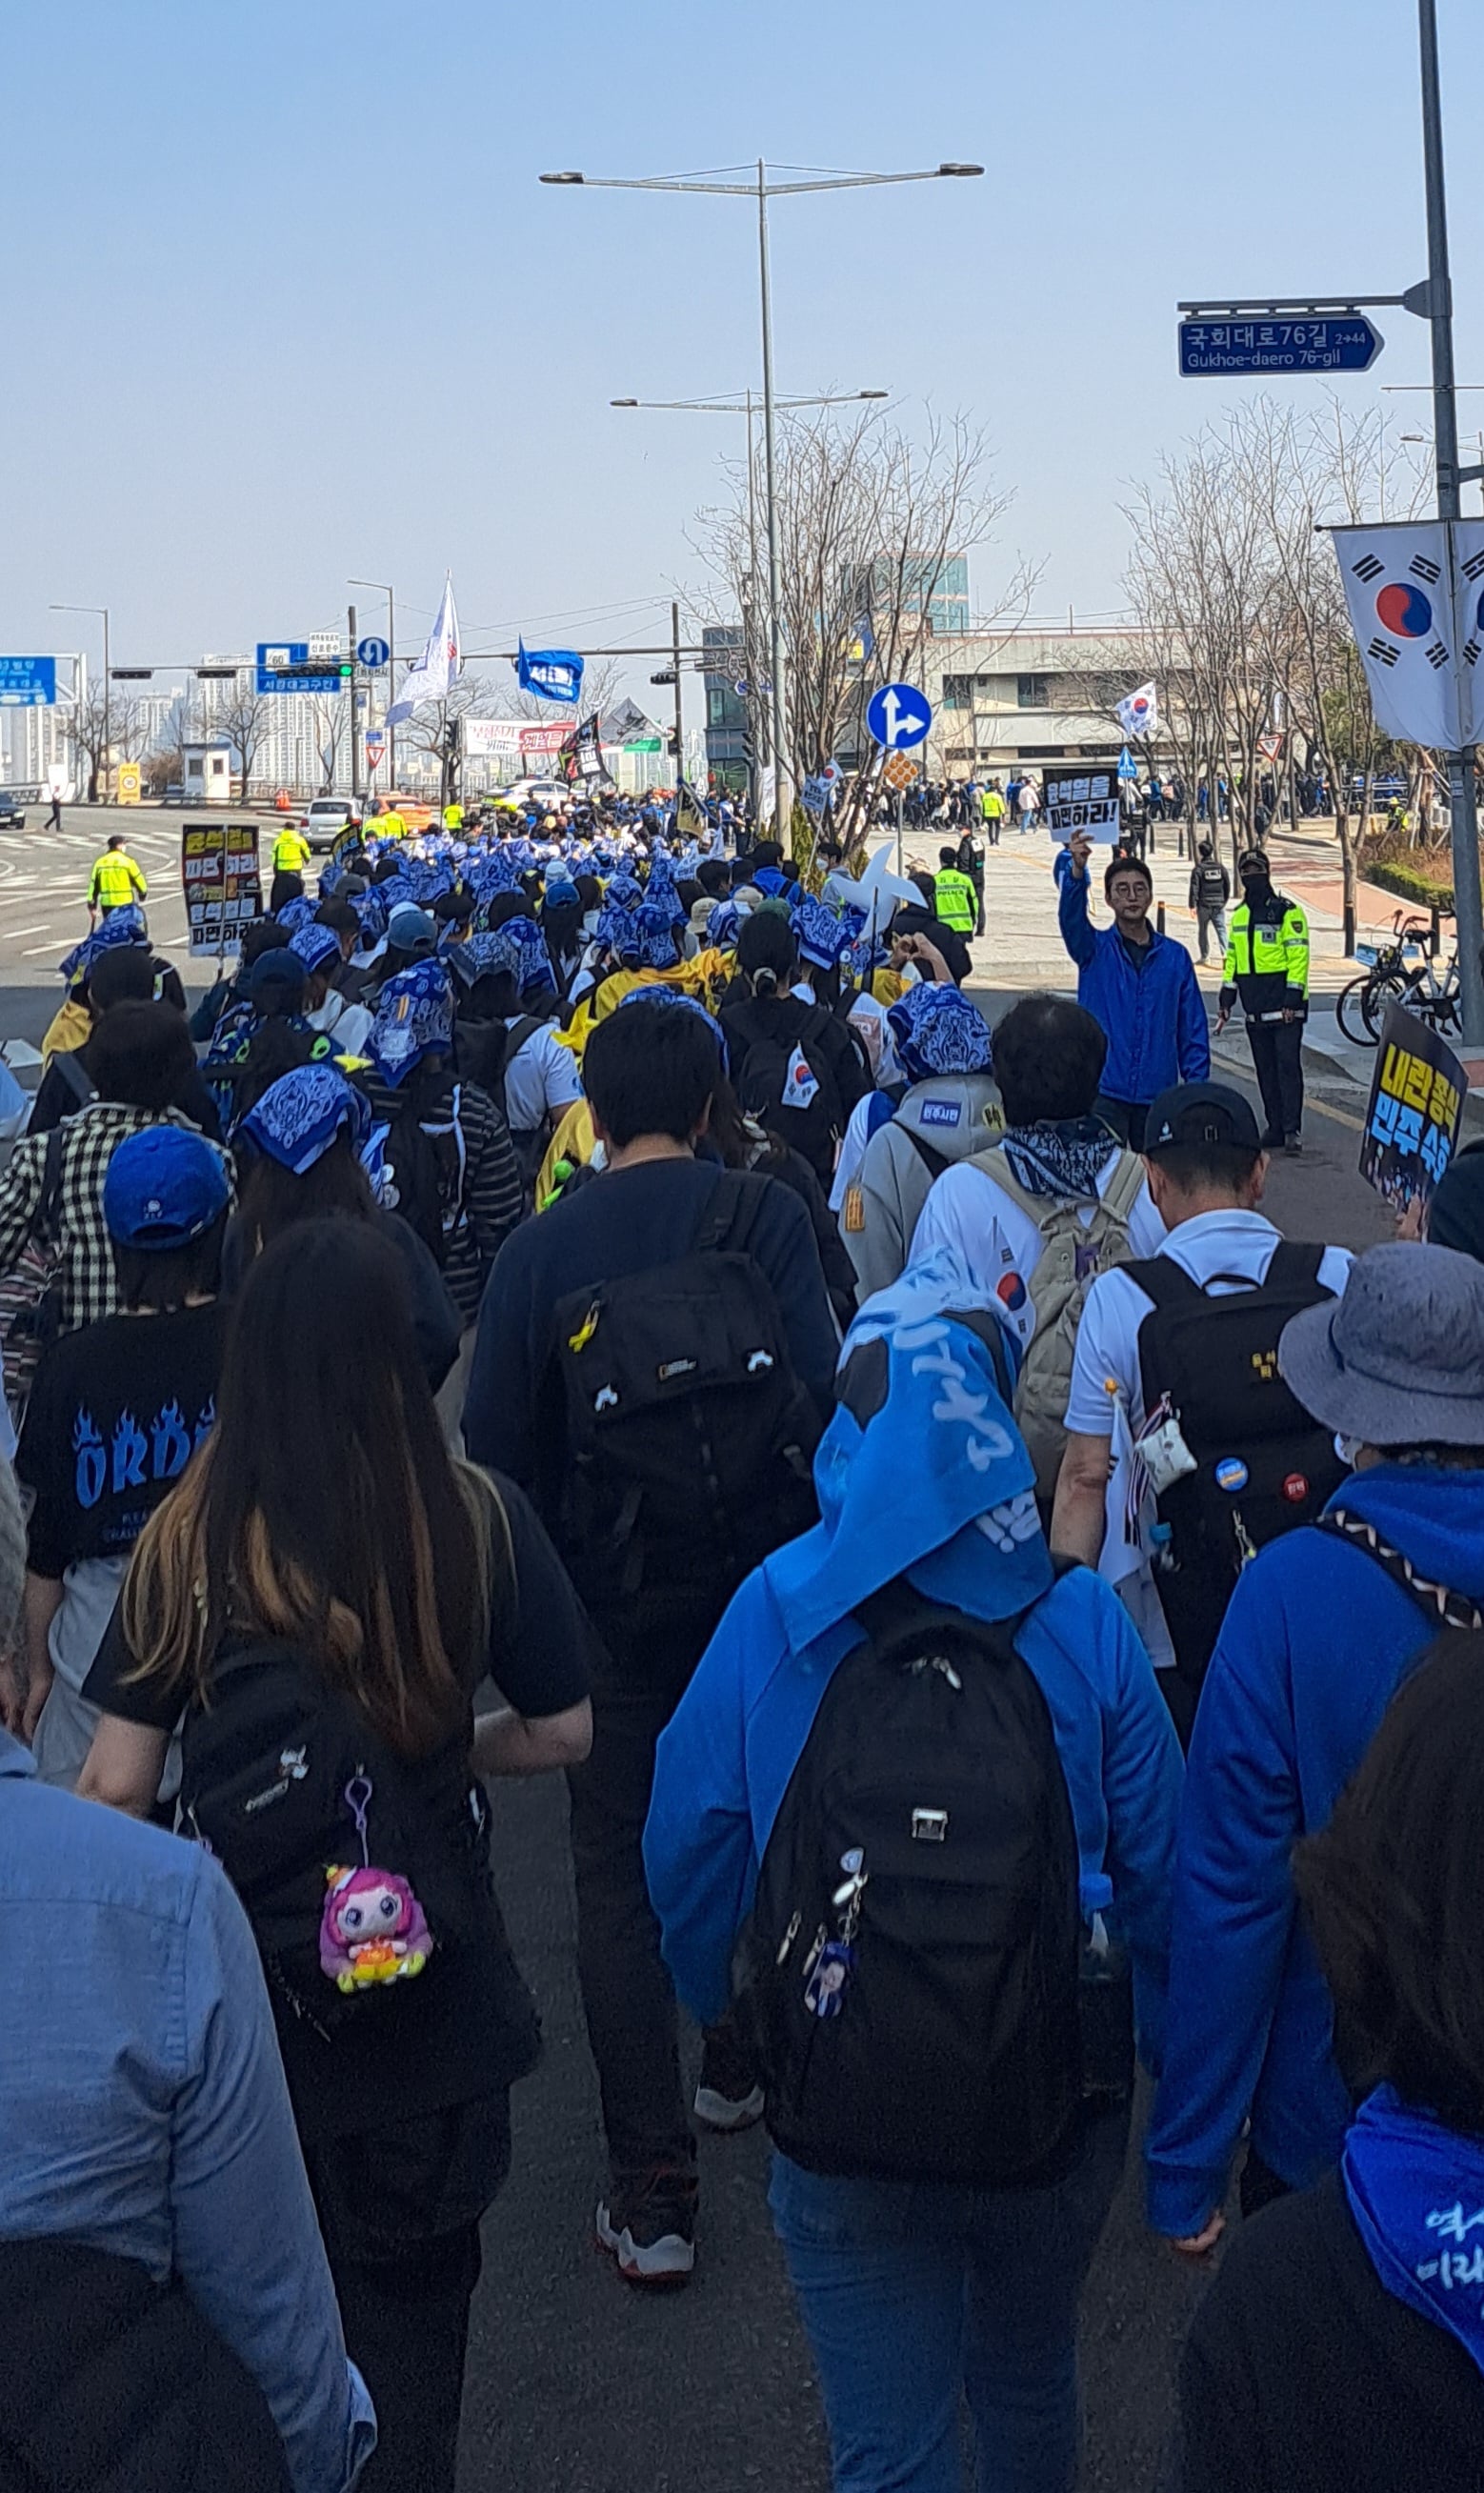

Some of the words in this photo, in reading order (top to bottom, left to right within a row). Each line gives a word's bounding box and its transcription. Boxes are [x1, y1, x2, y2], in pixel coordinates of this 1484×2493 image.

[1187, 324, 1328, 350] 국회대로76길
[1188, 351, 1293, 368] Gukhoe-daero
[1299, 349, 1341, 365] 76-gil
[1048, 775, 1111, 806] 윤석열을
[1051, 801, 1116, 830] 파면하라!
[1380, 1043, 1460, 1141] 내란종식
[1371, 1090, 1451, 1185] 민주수호
